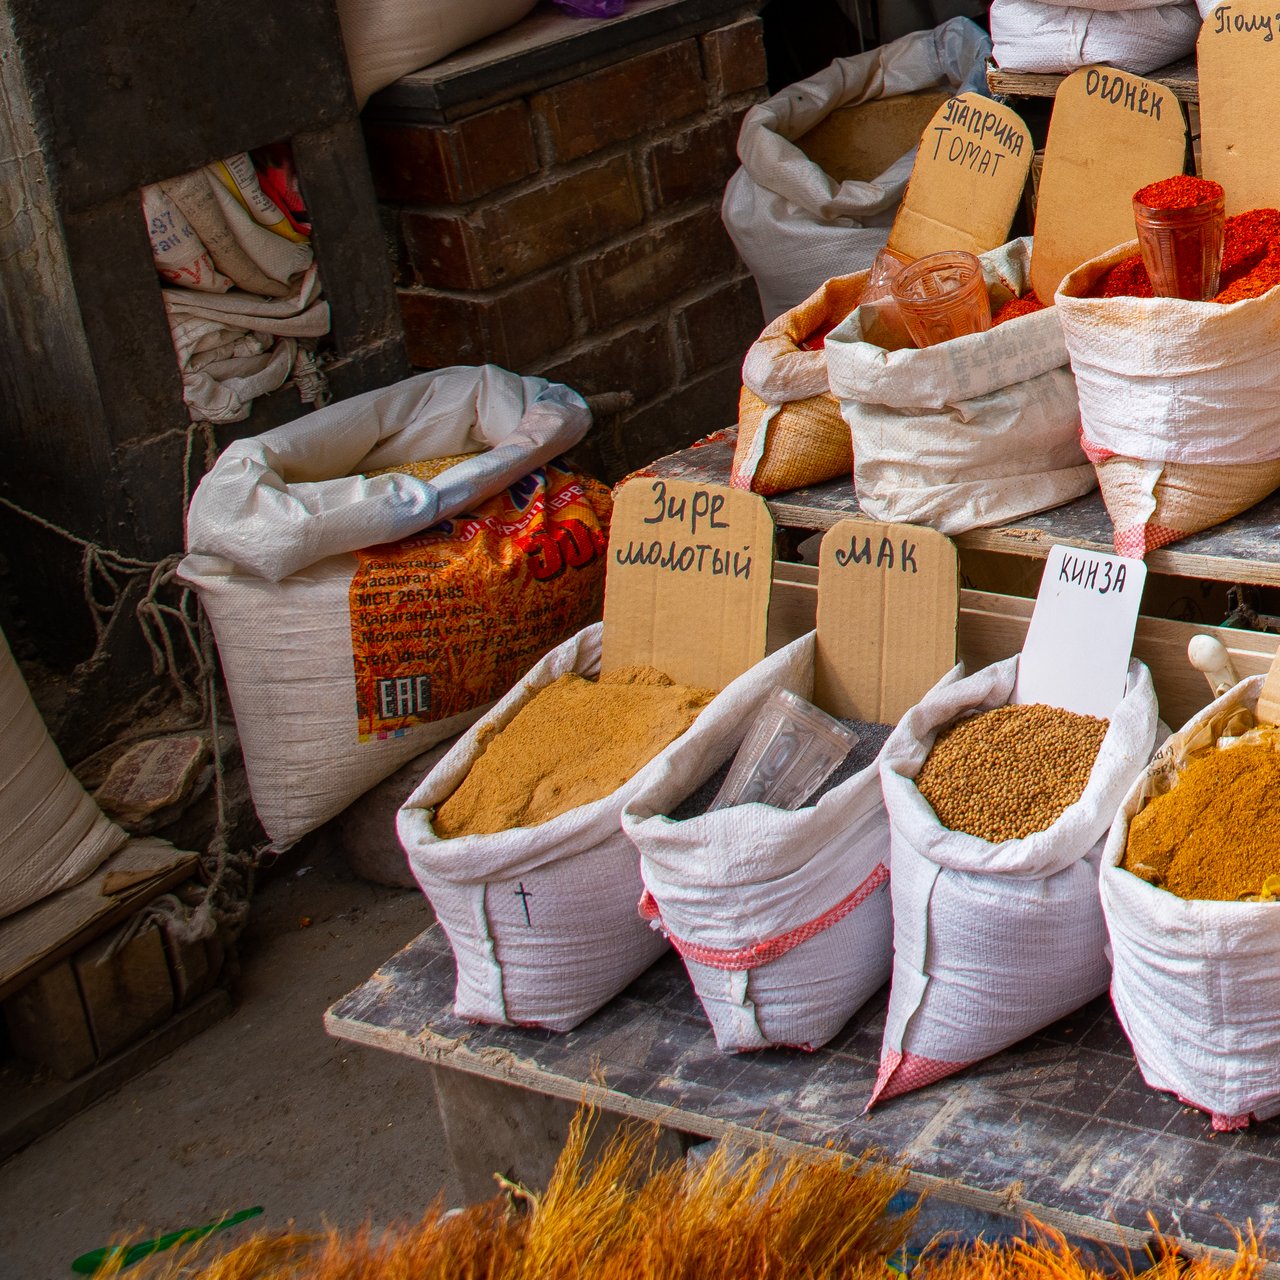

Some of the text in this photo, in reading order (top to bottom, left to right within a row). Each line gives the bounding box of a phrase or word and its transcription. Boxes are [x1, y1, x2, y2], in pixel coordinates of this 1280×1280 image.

[1085, 69, 1164, 121] ОГОНЁК
[942, 95, 1025, 156] ПАПРИКА
[932, 125, 1007, 178] ТОМАТ
[616, 540, 753, 581] молотый
[835, 534, 919, 575] МАК
[1057, 551, 1128, 596] КИНЗА
[358, 592, 392, 607] МСТ
[380, 676, 430, 718] EAC
